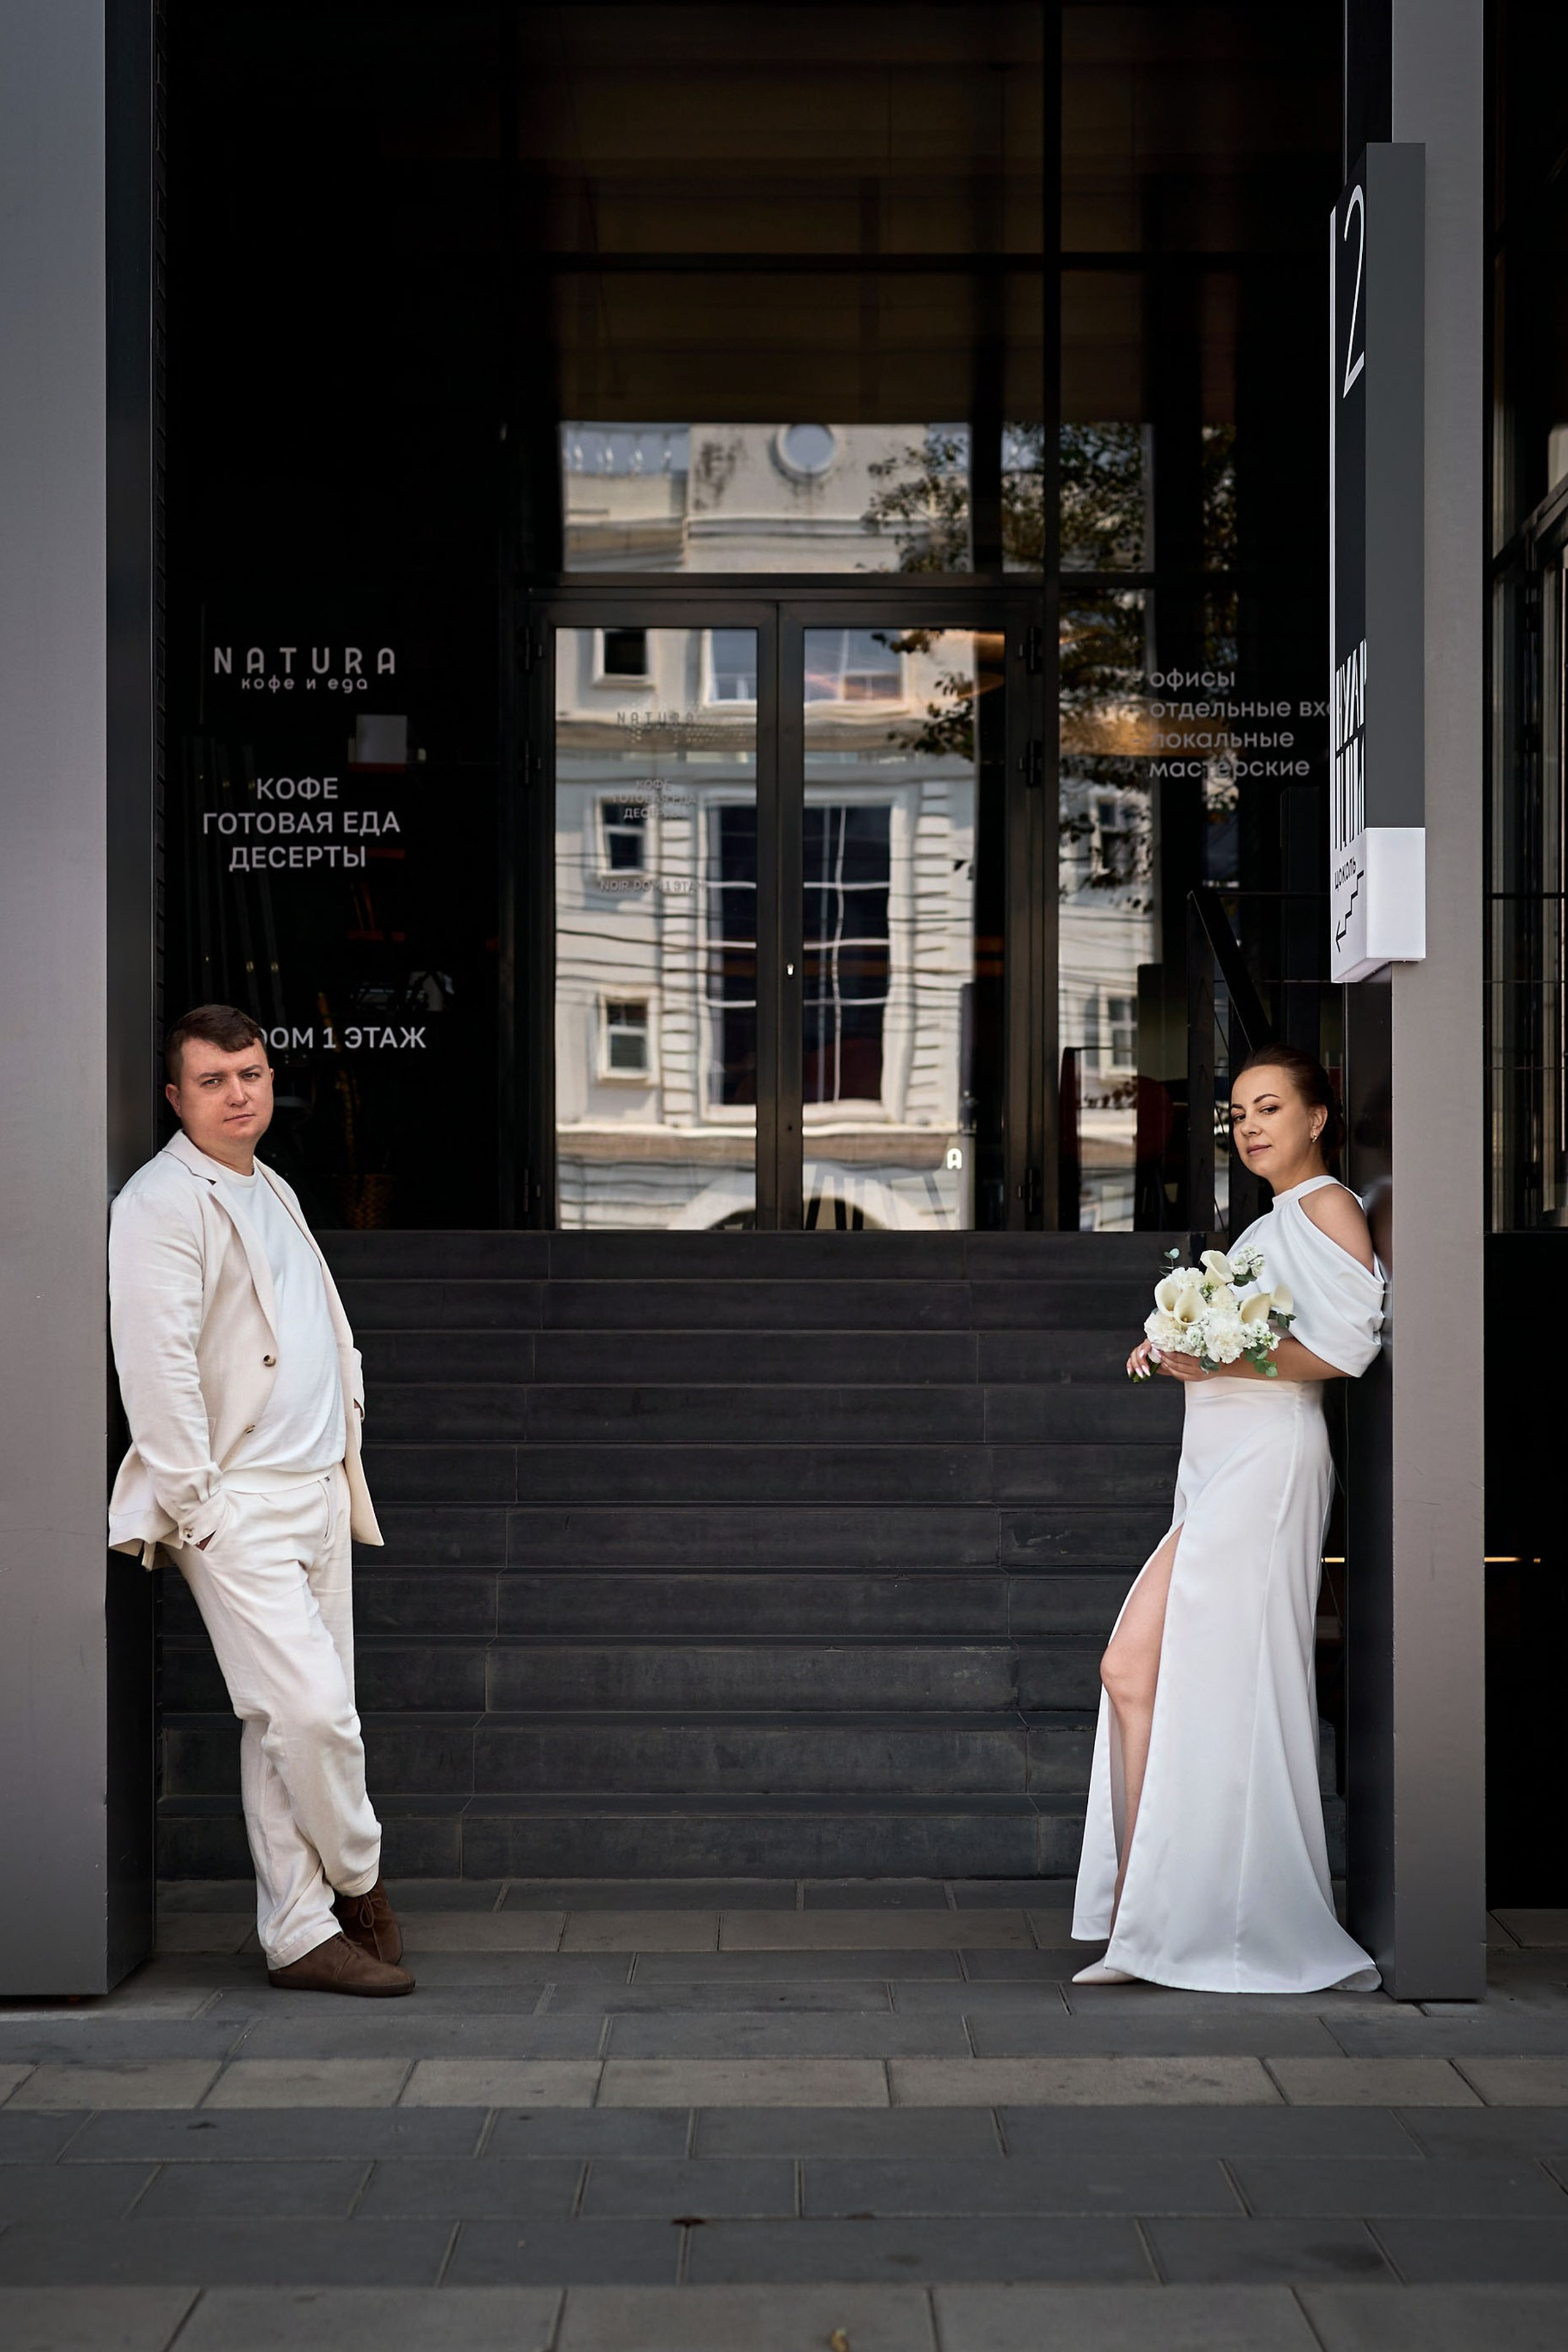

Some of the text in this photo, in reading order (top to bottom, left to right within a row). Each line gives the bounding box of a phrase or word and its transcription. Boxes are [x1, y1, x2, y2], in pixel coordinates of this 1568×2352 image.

[1343, 185, 1365, 399] 2
[214, 647, 395, 674] NATURA
[241, 675, 295, 693] кофе
[306, 678, 316, 690] и
[1150, 668, 1235, 692] офисы
[1150, 701, 1292, 720] отдельные
[1150, 732, 1294, 748] локальные
[1150, 760, 1310, 780] мастерские
[257, 777, 338, 799] КОФЕ
[203, 812, 401, 836] ГОТОВАЯ ЕДА
[229, 846, 366, 872] ДЕСЕРТЫ
[323, 1027, 337, 1048] 1
[344, 1027, 426, 1049] ЭТАЖ
